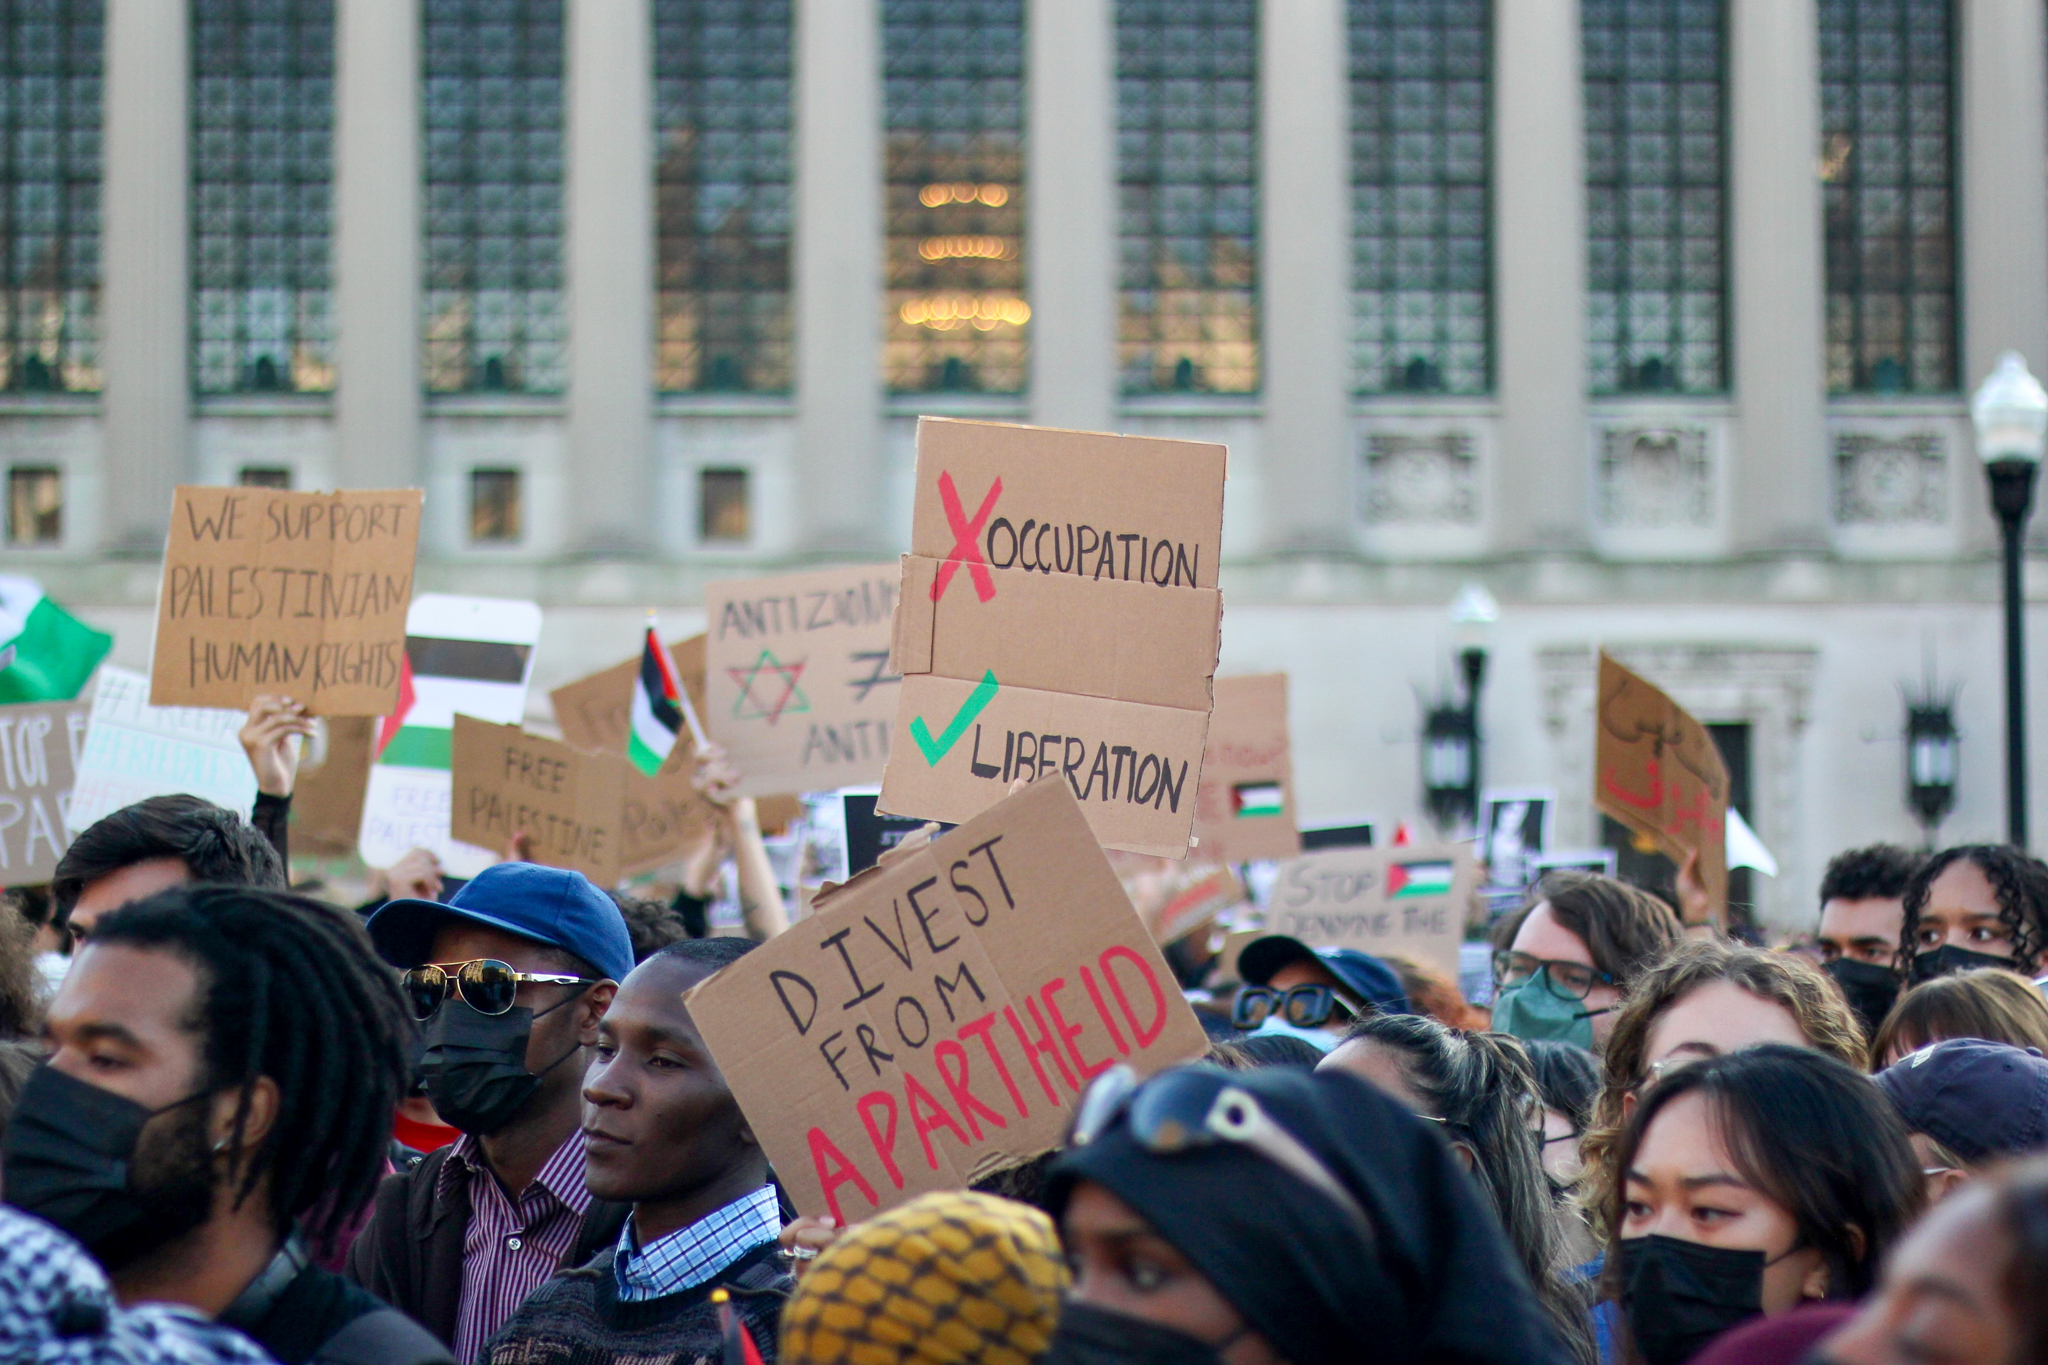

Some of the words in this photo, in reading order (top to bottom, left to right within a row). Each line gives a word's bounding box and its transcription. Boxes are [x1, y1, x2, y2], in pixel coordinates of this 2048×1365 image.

[186, 496, 246, 542] WE
[265, 501, 408, 544] SUPPORT
[987, 517, 1199, 588] OCCUPATION
[169, 565, 408, 620] PALESTINIAN
[190, 635, 309, 689] HUMAN
[313, 641, 400, 692] RIGHTS
[0, 714, 52, 790] TOP
[506, 747, 568, 794] FREE
[971, 723, 1189, 814] LIBERATION
[469, 785, 605, 867] PALESTINE
[1286, 861, 1379, 907] STOP
[769, 834, 1015, 1036] DIVEST
[1402, 906, 1449, 936] THE
[818, 961, 986, 1091] FROM
[806, 944, 1168, 1228] APARTHEID
